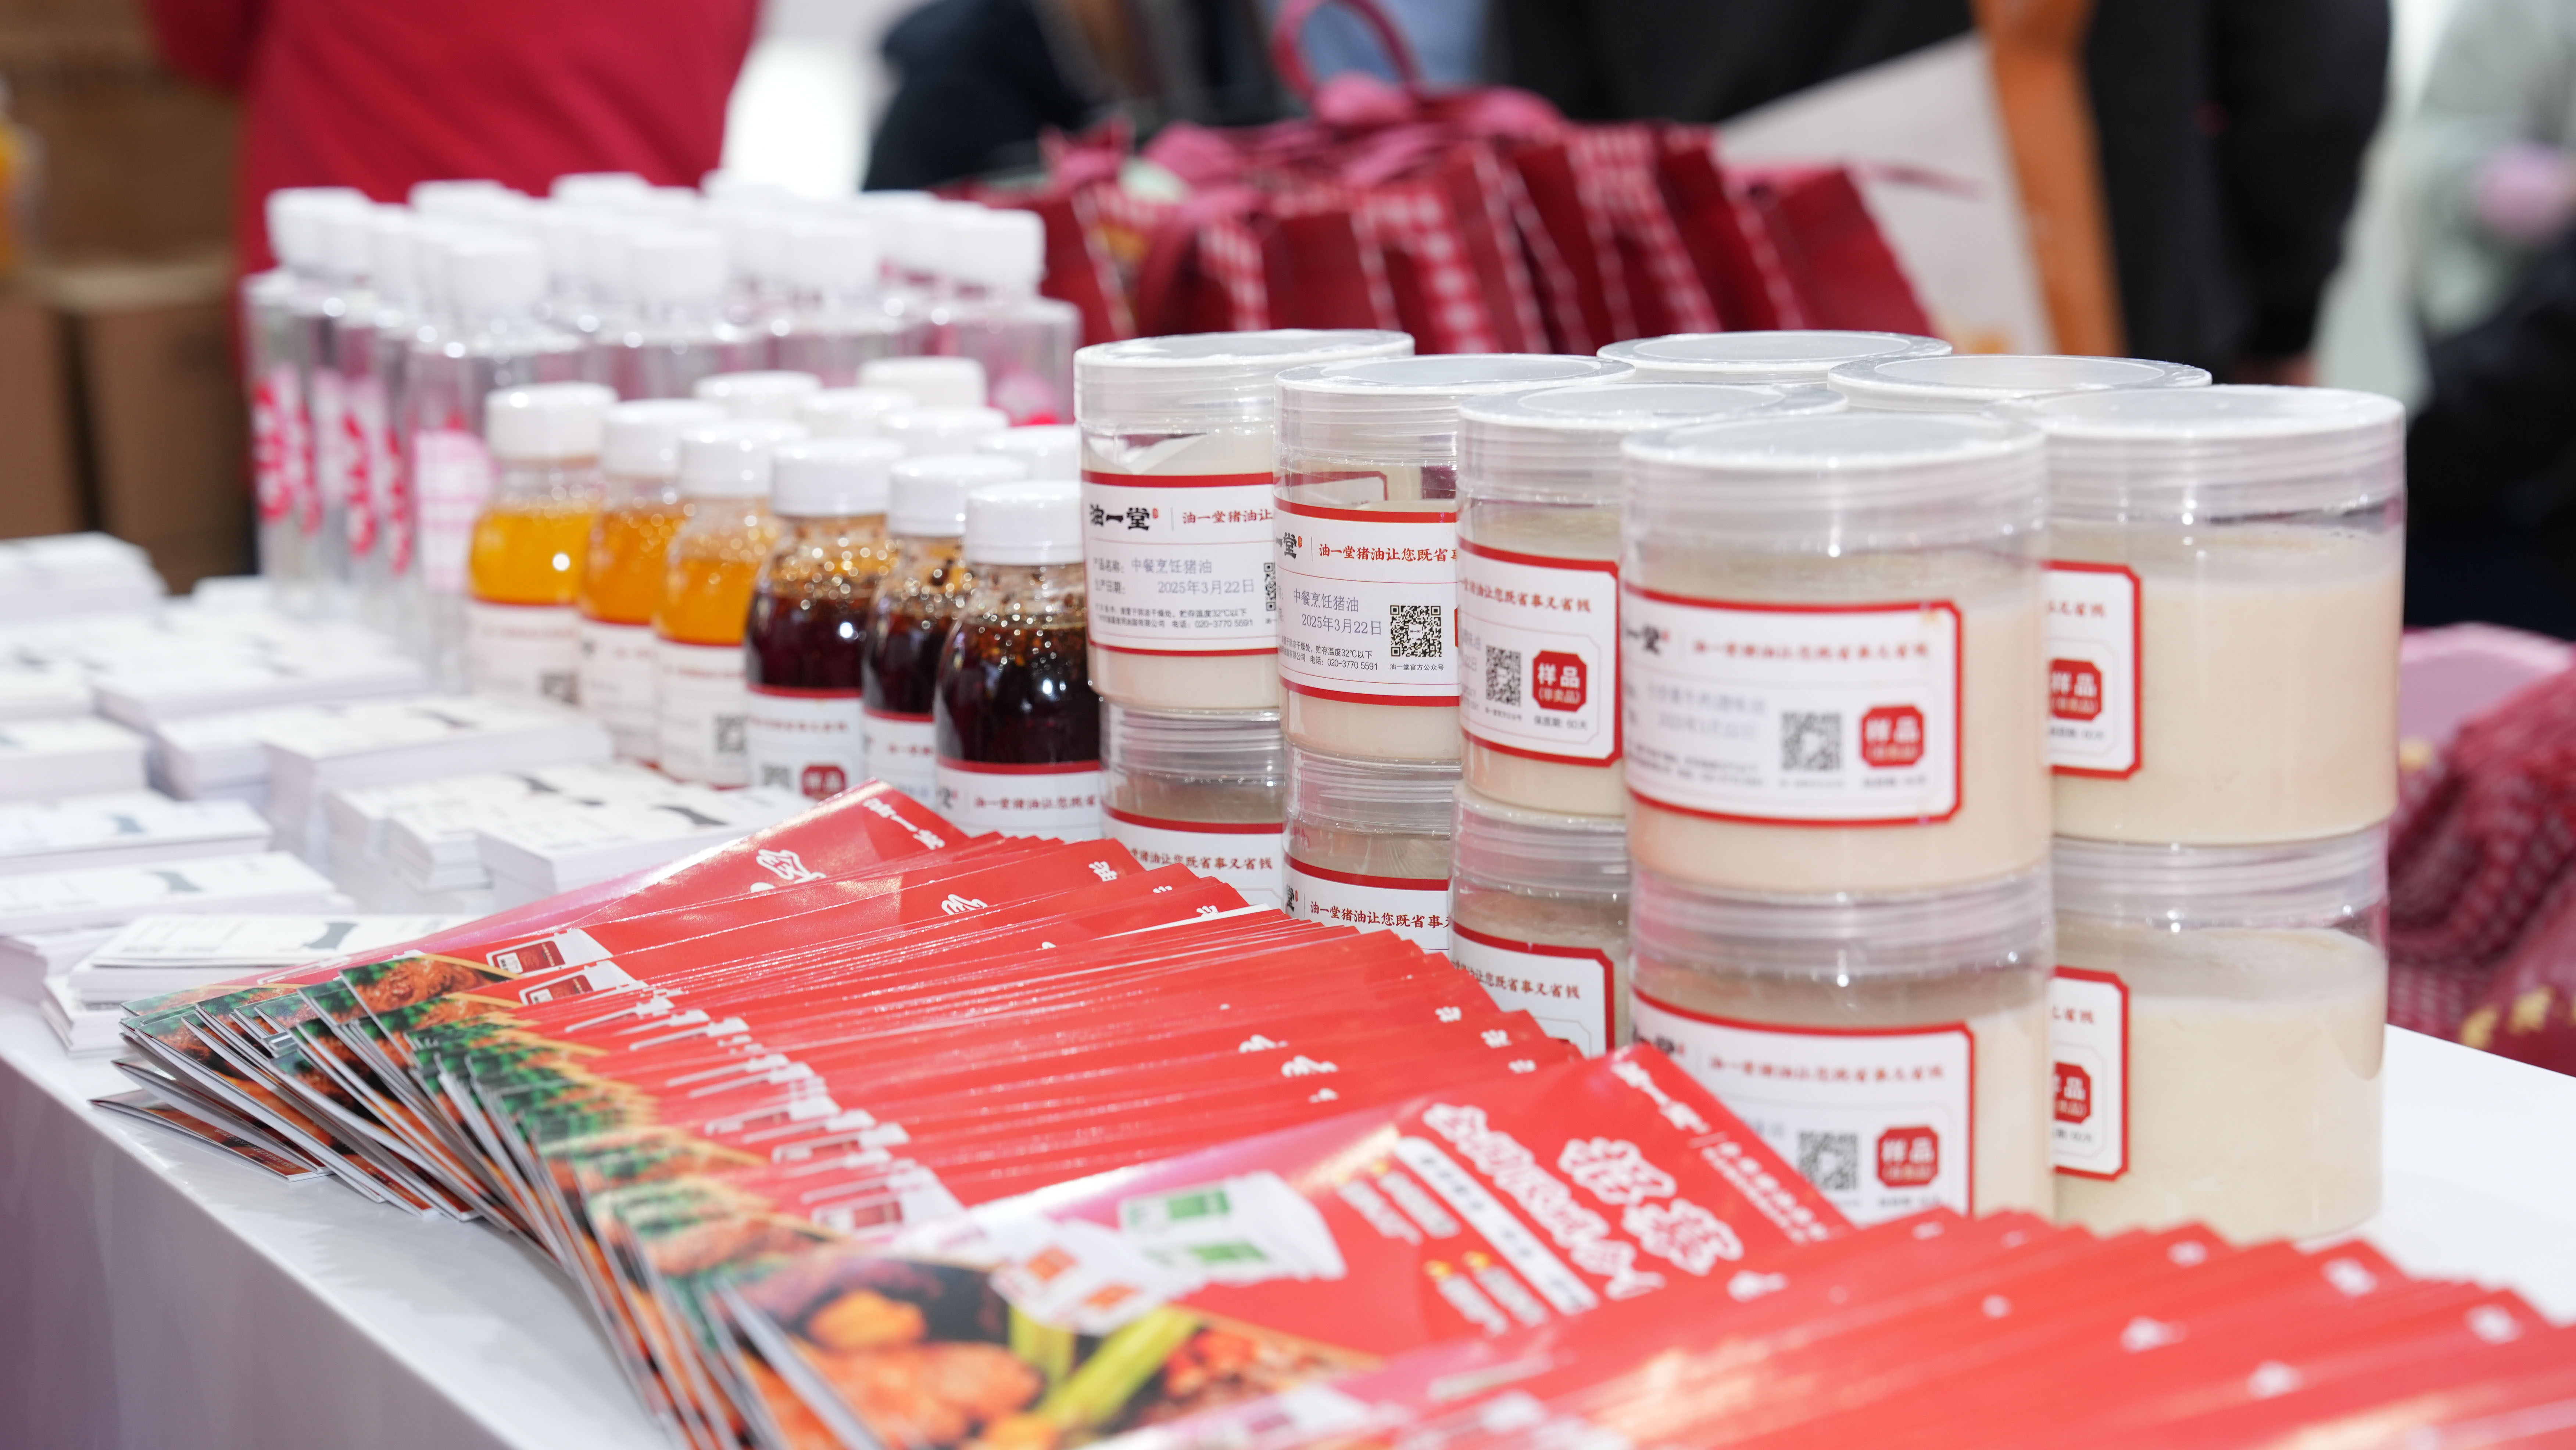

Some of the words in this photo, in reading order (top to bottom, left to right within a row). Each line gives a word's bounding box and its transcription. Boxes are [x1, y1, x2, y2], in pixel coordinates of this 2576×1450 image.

[1090, 504, 1150, 531] 油一堂
[1131, 557, 1213, 574] 中餐烹饪猪油
[1158, 579, 1255, 595] 2025年3月22日
[1293, 588, 1359, 612] 中餐烹饪猪油
[1302, 614, 1382, 636] 2025年3月22日
[1538, 663, 1580, 689] 样品
